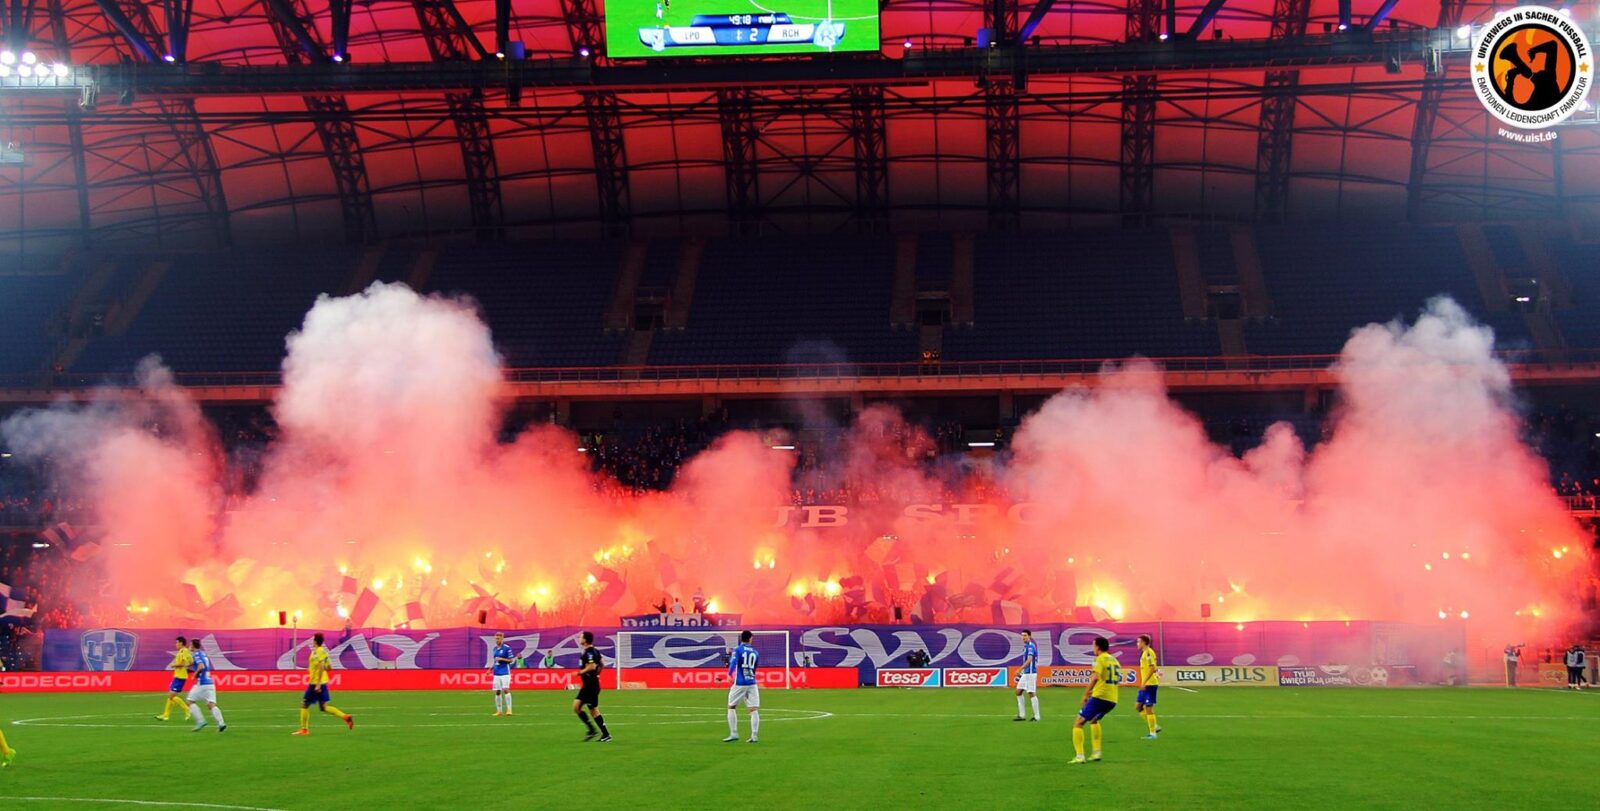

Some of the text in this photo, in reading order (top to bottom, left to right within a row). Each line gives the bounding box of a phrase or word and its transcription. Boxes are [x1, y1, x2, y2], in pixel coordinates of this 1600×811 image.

[749, 28, 758, 41] 2
[741, 651, 757, 669] 10
[440, 672, 572, 685] MODCOM
[672, 671, 806, 683] MODCOM
[882, 671, 921, 684] tesa
[949, 671, 988, 684] tesa
[1052, 669, 1093, 677] ZAKŁAD
[1105, 664, 1122, 685] 15
[1178, 671, 1205, 680] LECH
[1220, 667, 1267, 682] PILS
[0, 675, 112, 688] ODECOM
